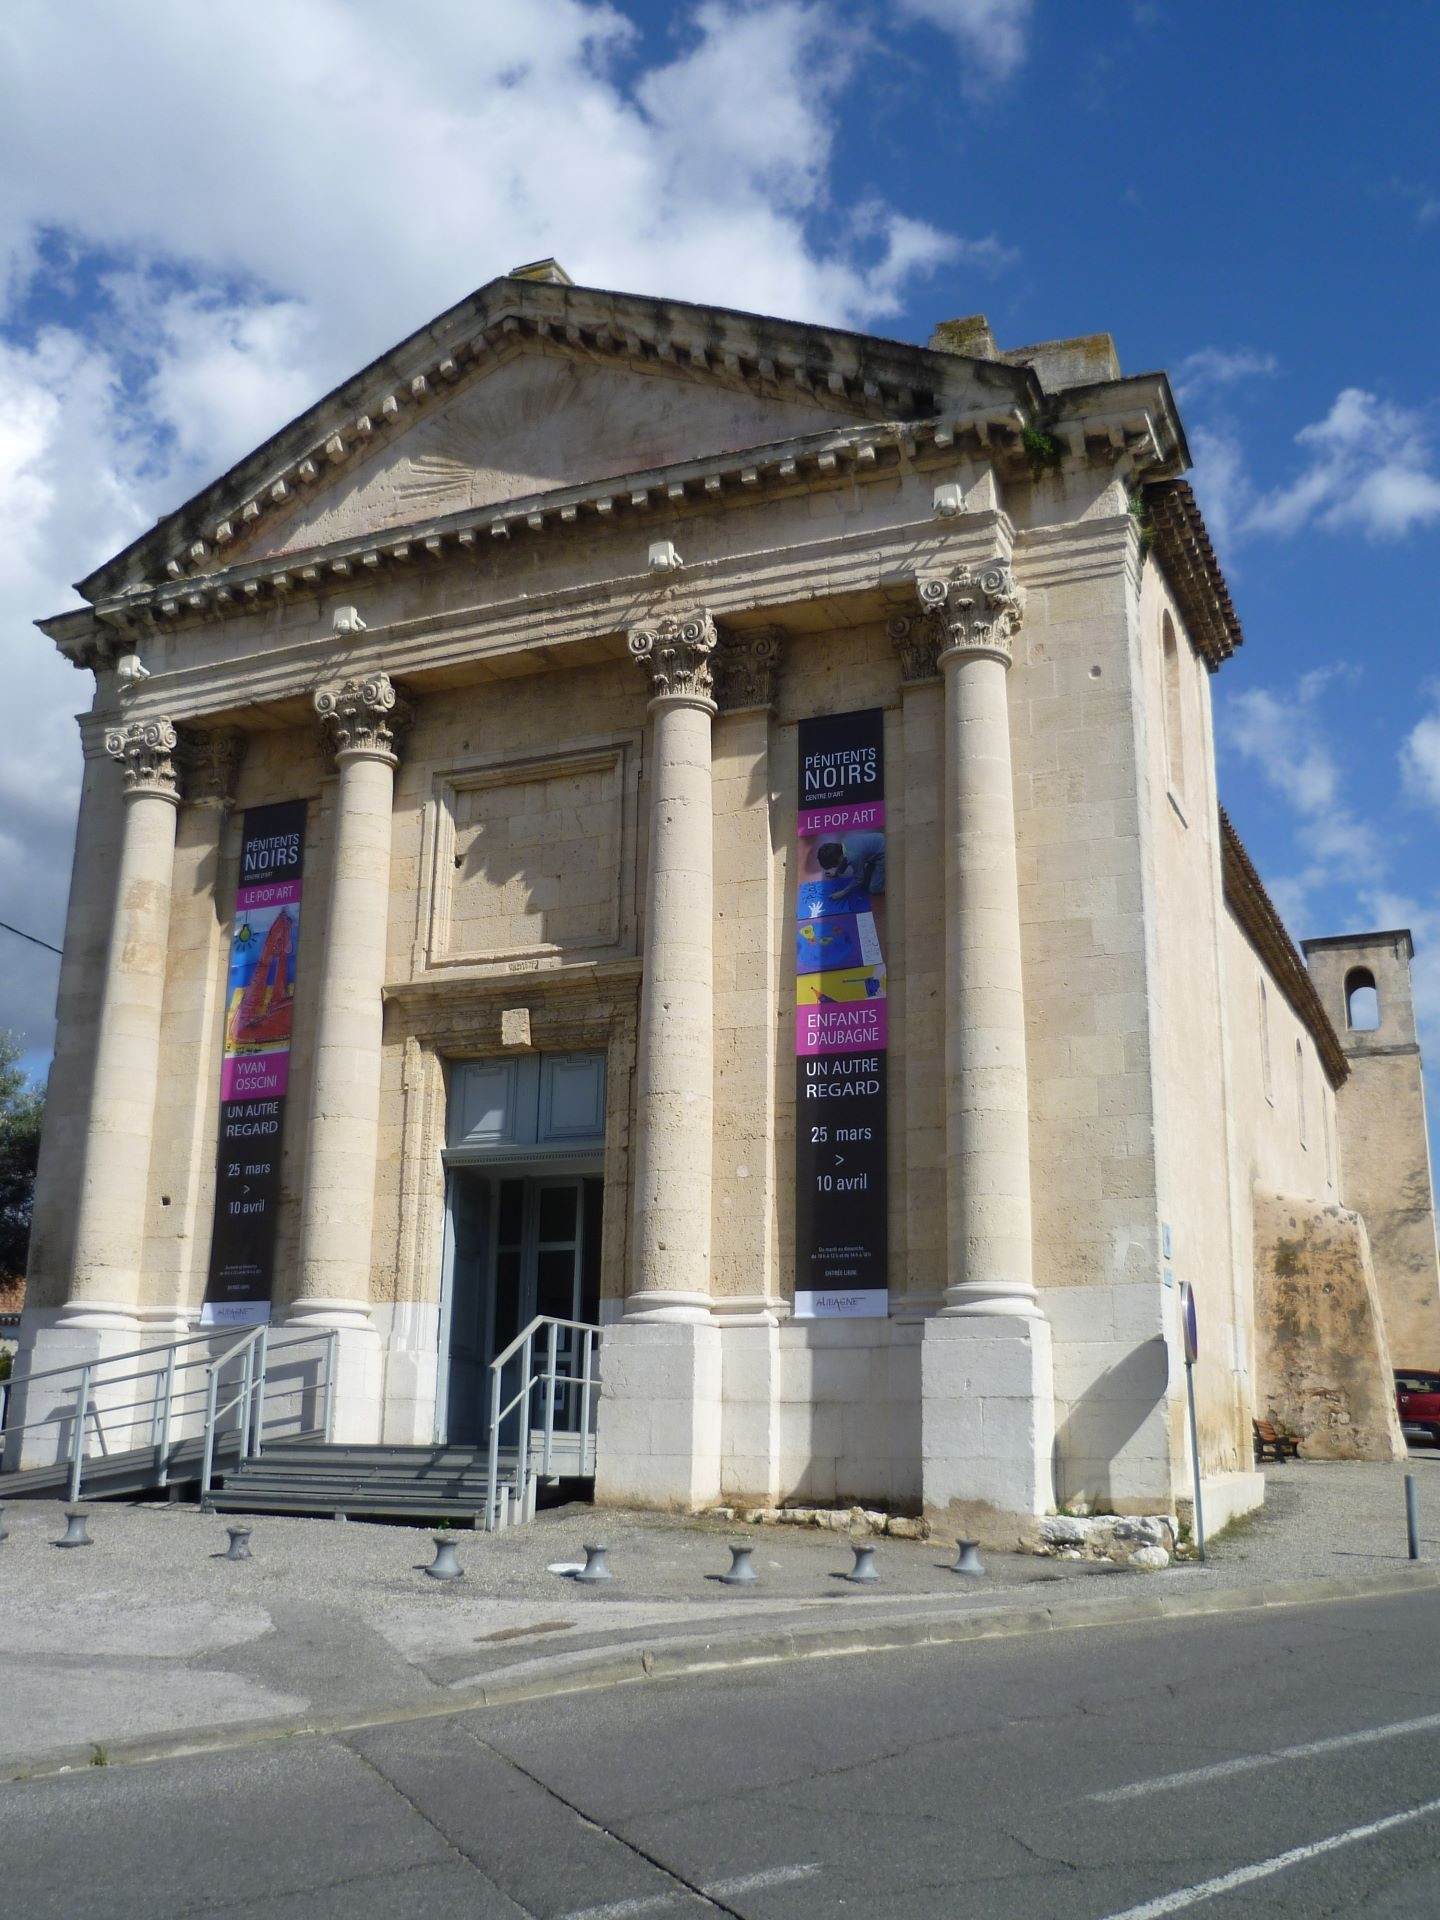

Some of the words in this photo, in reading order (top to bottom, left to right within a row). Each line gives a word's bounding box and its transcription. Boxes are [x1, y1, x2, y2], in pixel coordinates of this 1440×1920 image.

[805, 747, 876, 769] PÉNITENTS
[805, 762, 877, 790] NOIRS
[805, 792, 827, 801] CENTRE
[828, 790, 844, 799] D'ART
[807, 814, 821, 829] LE
[824, 811, 849, 827] POP
[852, 808, 876, 824] ART
[247, 833, 300, 852] PÉNITENTS
[245, 846, 298, 871] NOIRS
[245, 892, 255, 903] LE
[257, 889, 275, 902] POP
[277, 886, 294, 899] ART
[808, 1009, 877, 1028] ENFANTS
[807, 1027, 879, 1046] D'AUBAGNE
[237, 1062, 266, 1074] YVAN
[806, 1060, 828, 1076] UN
[832, 1058, 878, 1075] AUTRE
[236, 1075, 277, 1090] OSSCINI
[806, 1080, 880, 1098] REGARD
[227, 1105, 244, 1118] UN
[246, 1102, 279, 1117] AUTRE
[226, 1120, 278, 1137] REGARD
[811, 1126, 828, 1143] 25
[836, 1126, 872, 1141] mars
[228, 1163, 241, 1177] 25
[245, 1161, 271, 1175] mars
[817, 1175, 832, 1191] 10
[836, 1172, 867, 1190] avril
[229, 1201, 241, 1214] 10
[243, 1199, 265, 1214] avril
[816, 1296, 866, 1311] AUBAGNE
